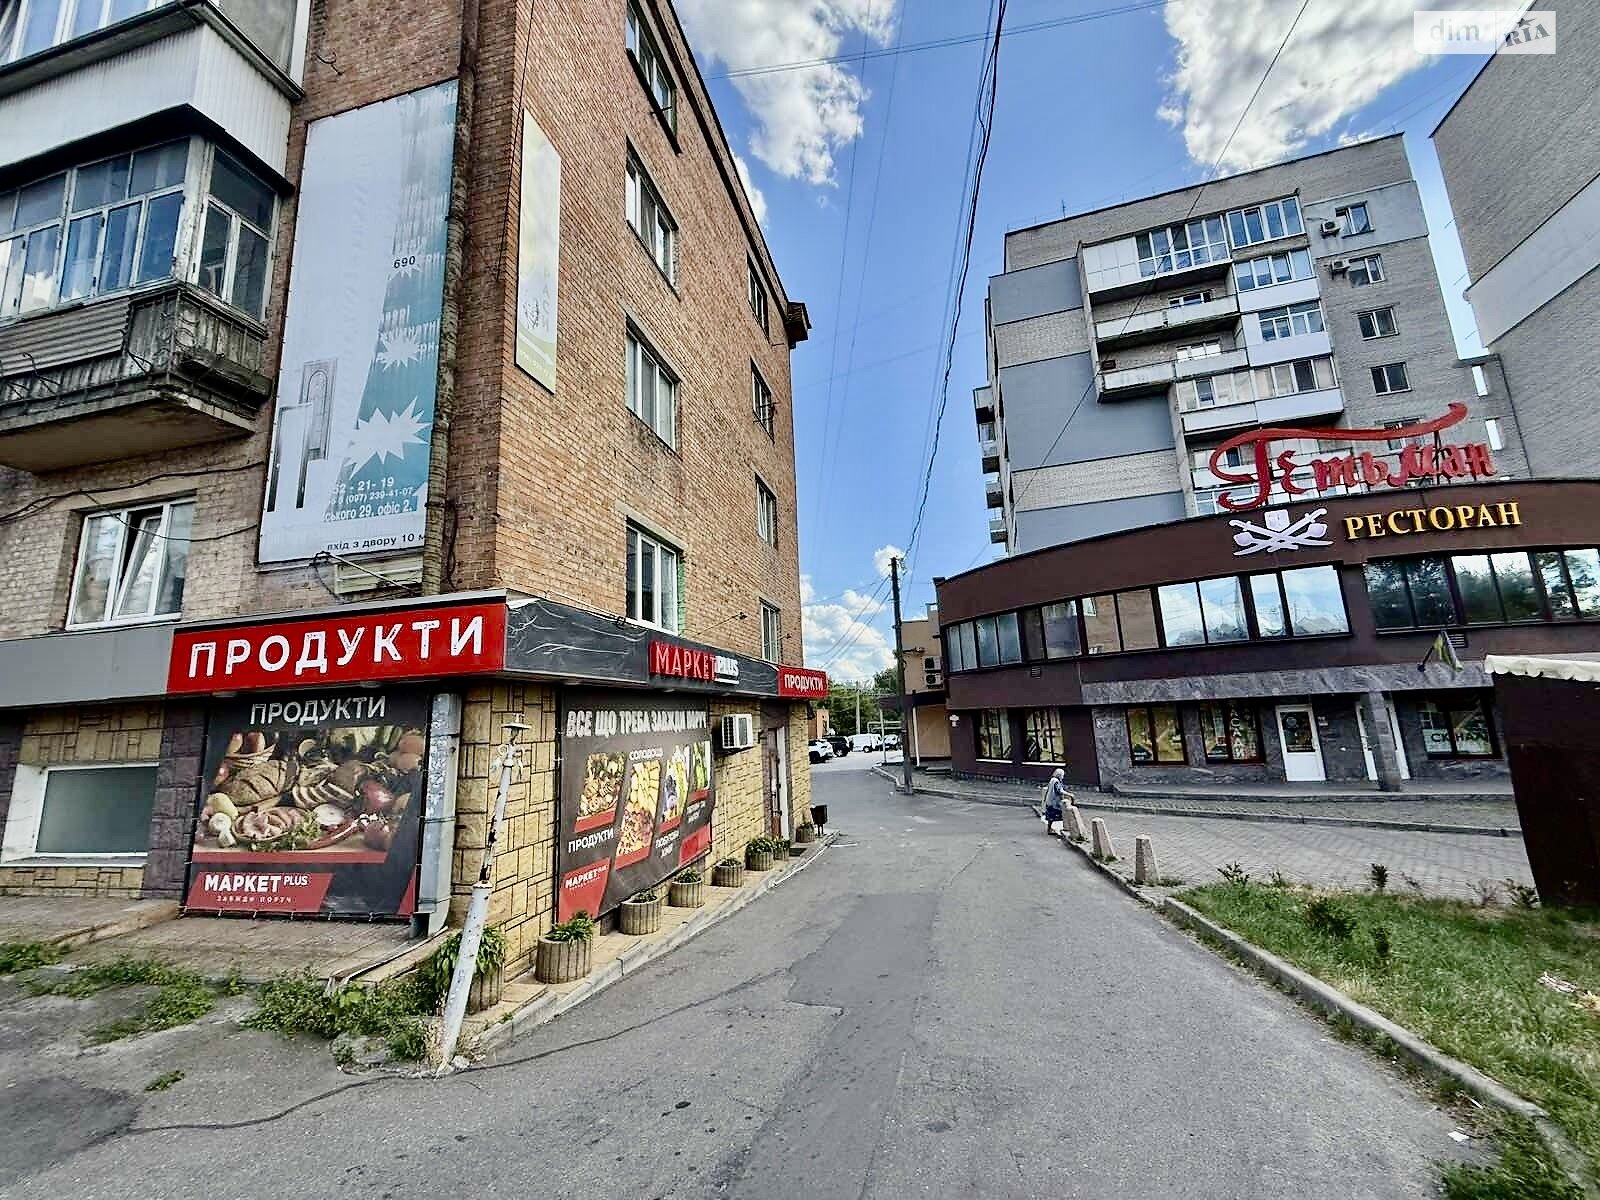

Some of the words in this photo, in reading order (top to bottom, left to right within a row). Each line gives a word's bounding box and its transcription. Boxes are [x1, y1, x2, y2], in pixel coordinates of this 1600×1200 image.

[393, 255, 416, 269] 690
[1344, 502, 1521, 540] РЕСТОРАН
[362, 536, 397, 549] двору
[402, 533, 415, 543] 10
[188, 615, 484, 678] ПРОДУКТИ
[654, 642, 716, 680] МАРКЕТ
[784, 673, 823, 692] ПРОДУКТИ
[250, 695, 386, 726] ПРОДУКТИ
[566, 710, 593, 738] ВСЕ
[595, 710, 617, 738] ЩО
[619, 710, 651, 734] ТРЕБА
[568, 827, 614, 854] ПРОДУКТИ
[204, 874, 281, 893] МАРКЕТ
[283, 875, 308, 886] PLUS
[565, 868, 598, 889] МАРКЕТ
